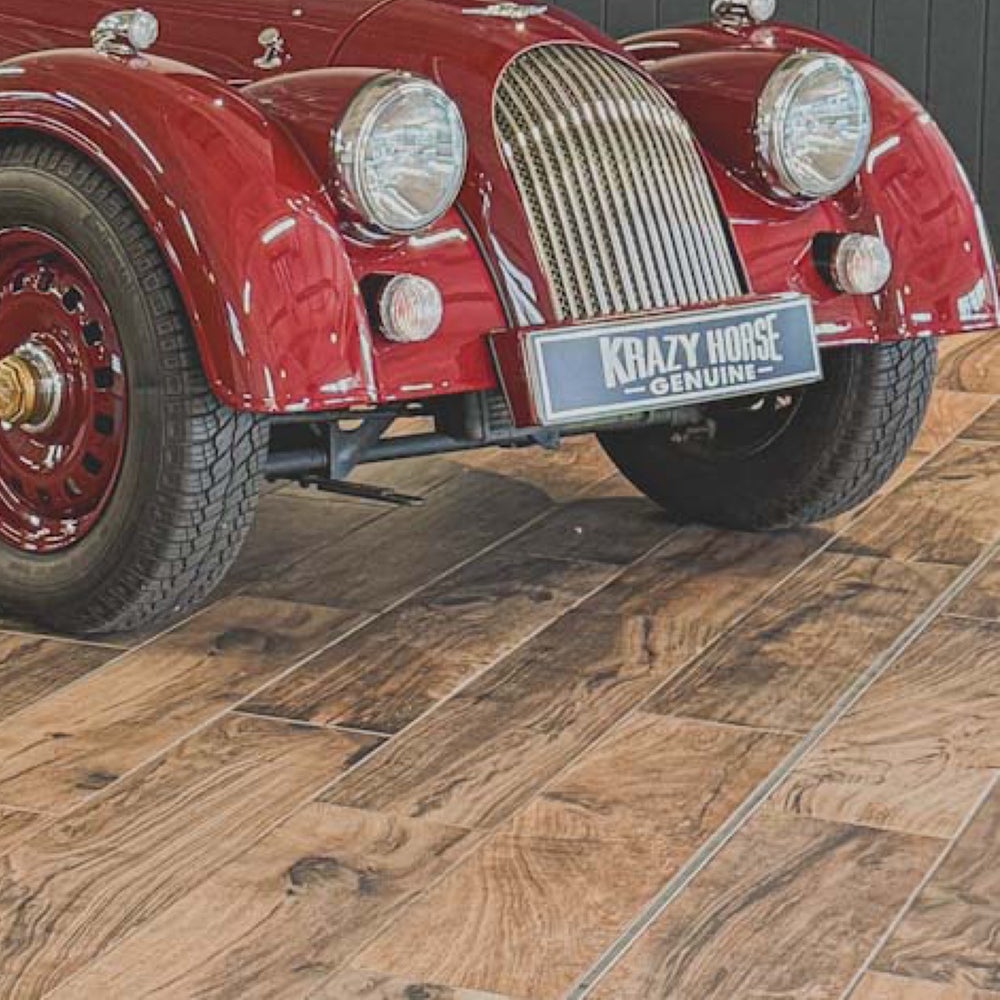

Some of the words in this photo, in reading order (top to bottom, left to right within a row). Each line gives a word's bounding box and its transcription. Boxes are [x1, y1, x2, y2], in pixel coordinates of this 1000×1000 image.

[600, 332, 700, 388] KRAZY
[706, 314, 783, 364] HORSE
[650, 364, 756, 396] GENUINE
